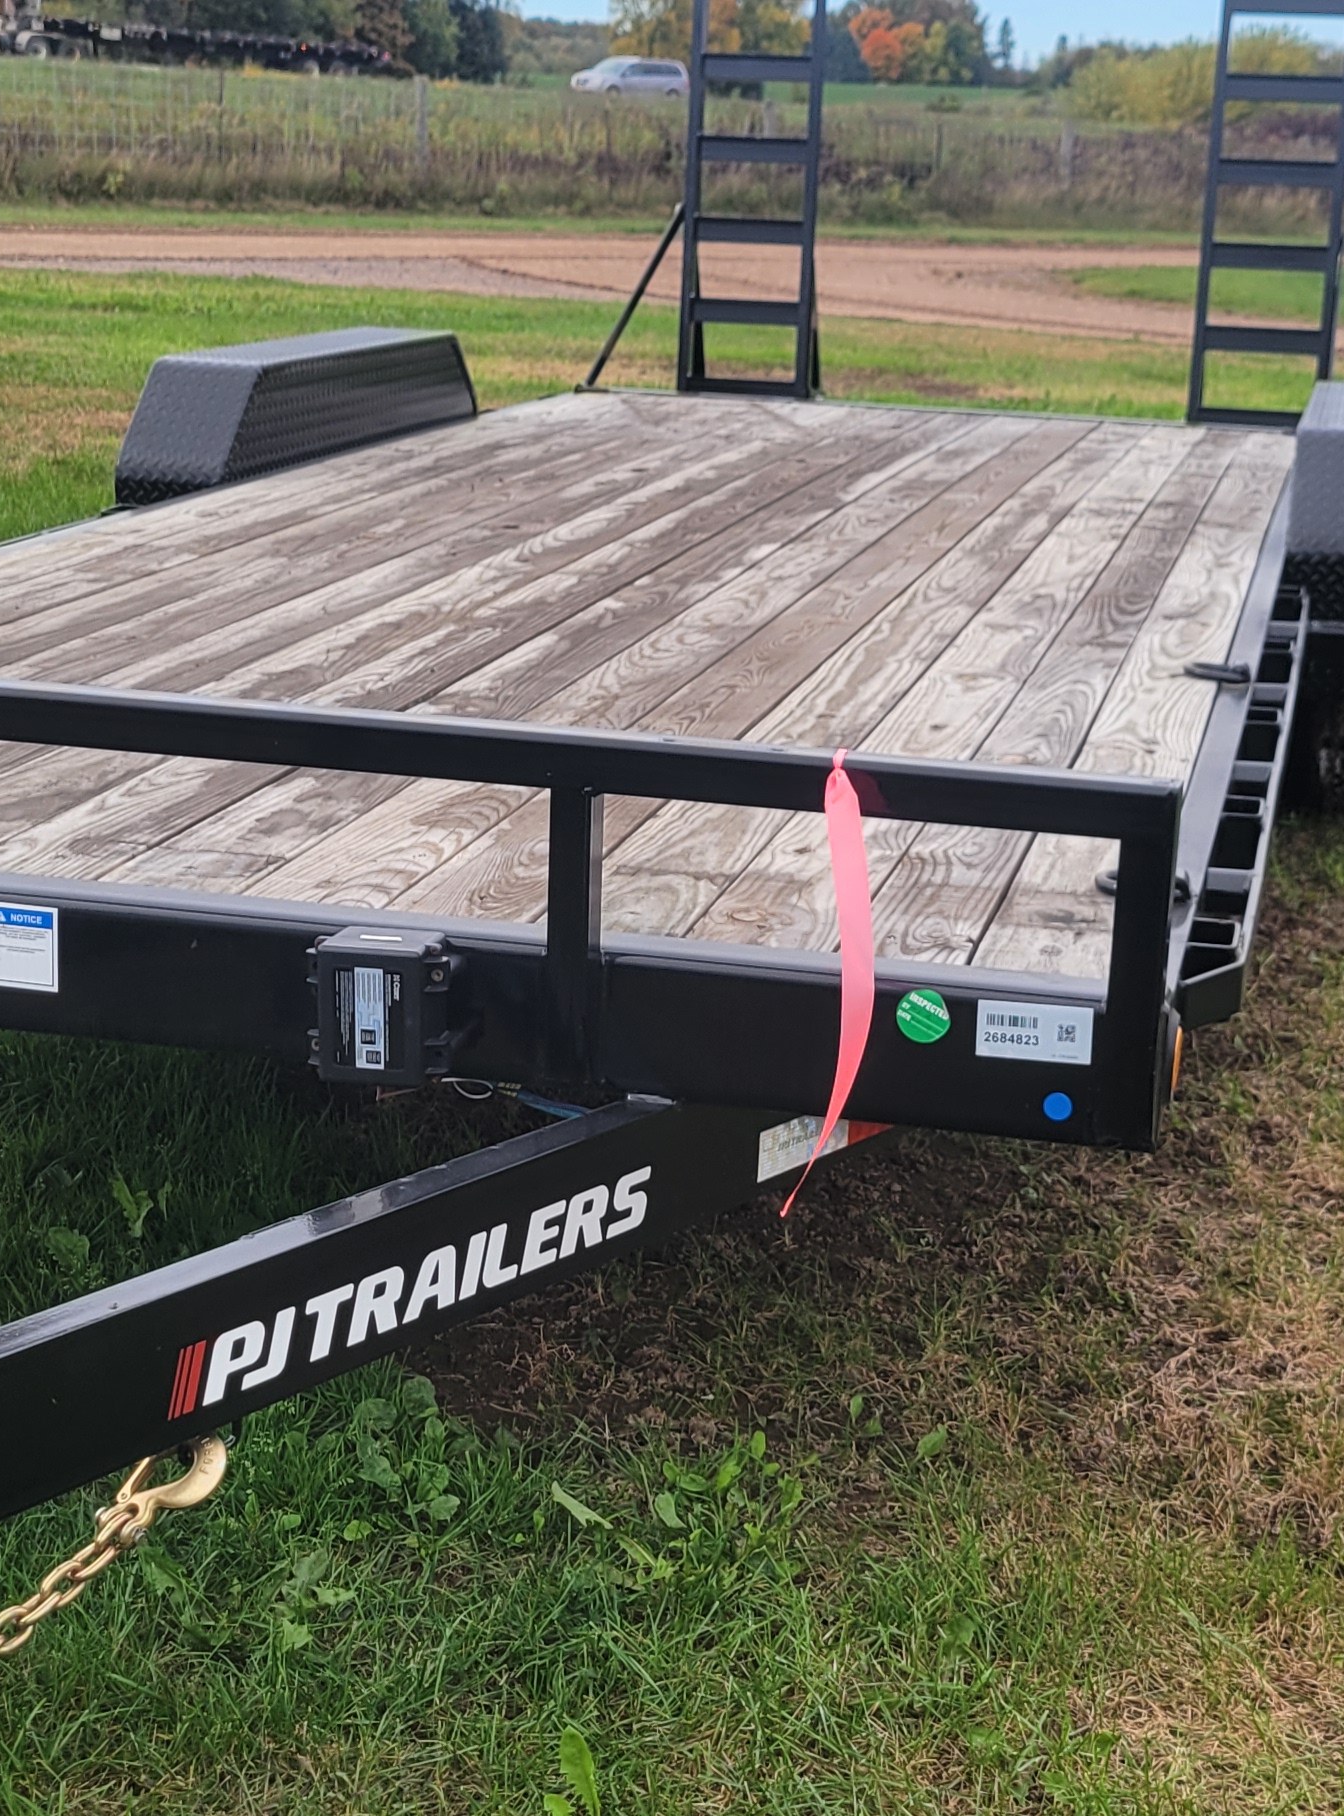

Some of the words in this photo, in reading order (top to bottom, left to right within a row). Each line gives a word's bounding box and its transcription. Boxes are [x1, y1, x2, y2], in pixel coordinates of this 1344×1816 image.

[10, 912, 43, 925] NOTICE
[909, 991, 950, 1020] INSPECTED
[983, 1030, 1040, 1047] 2684823
[202, 1306, 296, 1407] PJ
[305, 1165, 652, 1363] TRAILERS
